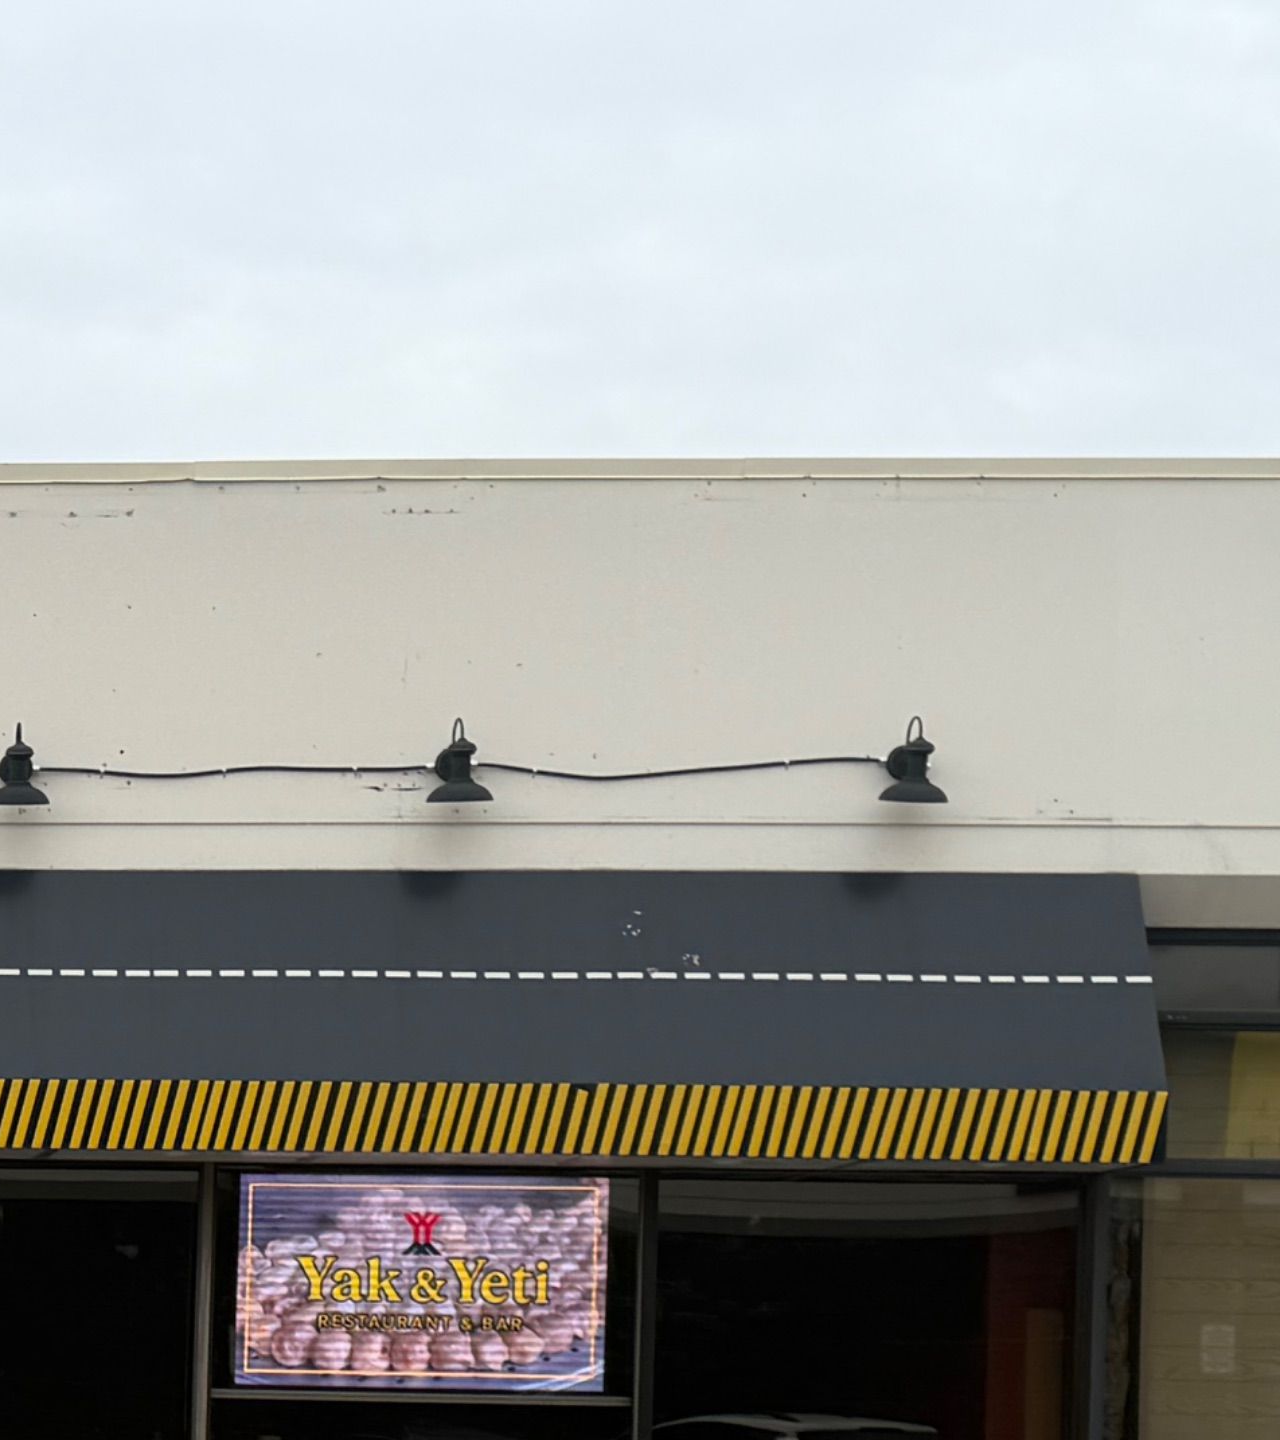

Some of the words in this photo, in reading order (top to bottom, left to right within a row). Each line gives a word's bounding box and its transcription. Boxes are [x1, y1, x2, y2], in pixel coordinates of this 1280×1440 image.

[295, 1255, 401, 1303] Yak
[410, 1267, 448, 1304] &
[449, 1256, 550, 1304] Yeti
[317, 1313, 452, 1331] RESTAURANT
[459, 1314, 475, 1331] &
[482, 1315, 524, 1332] BAR
